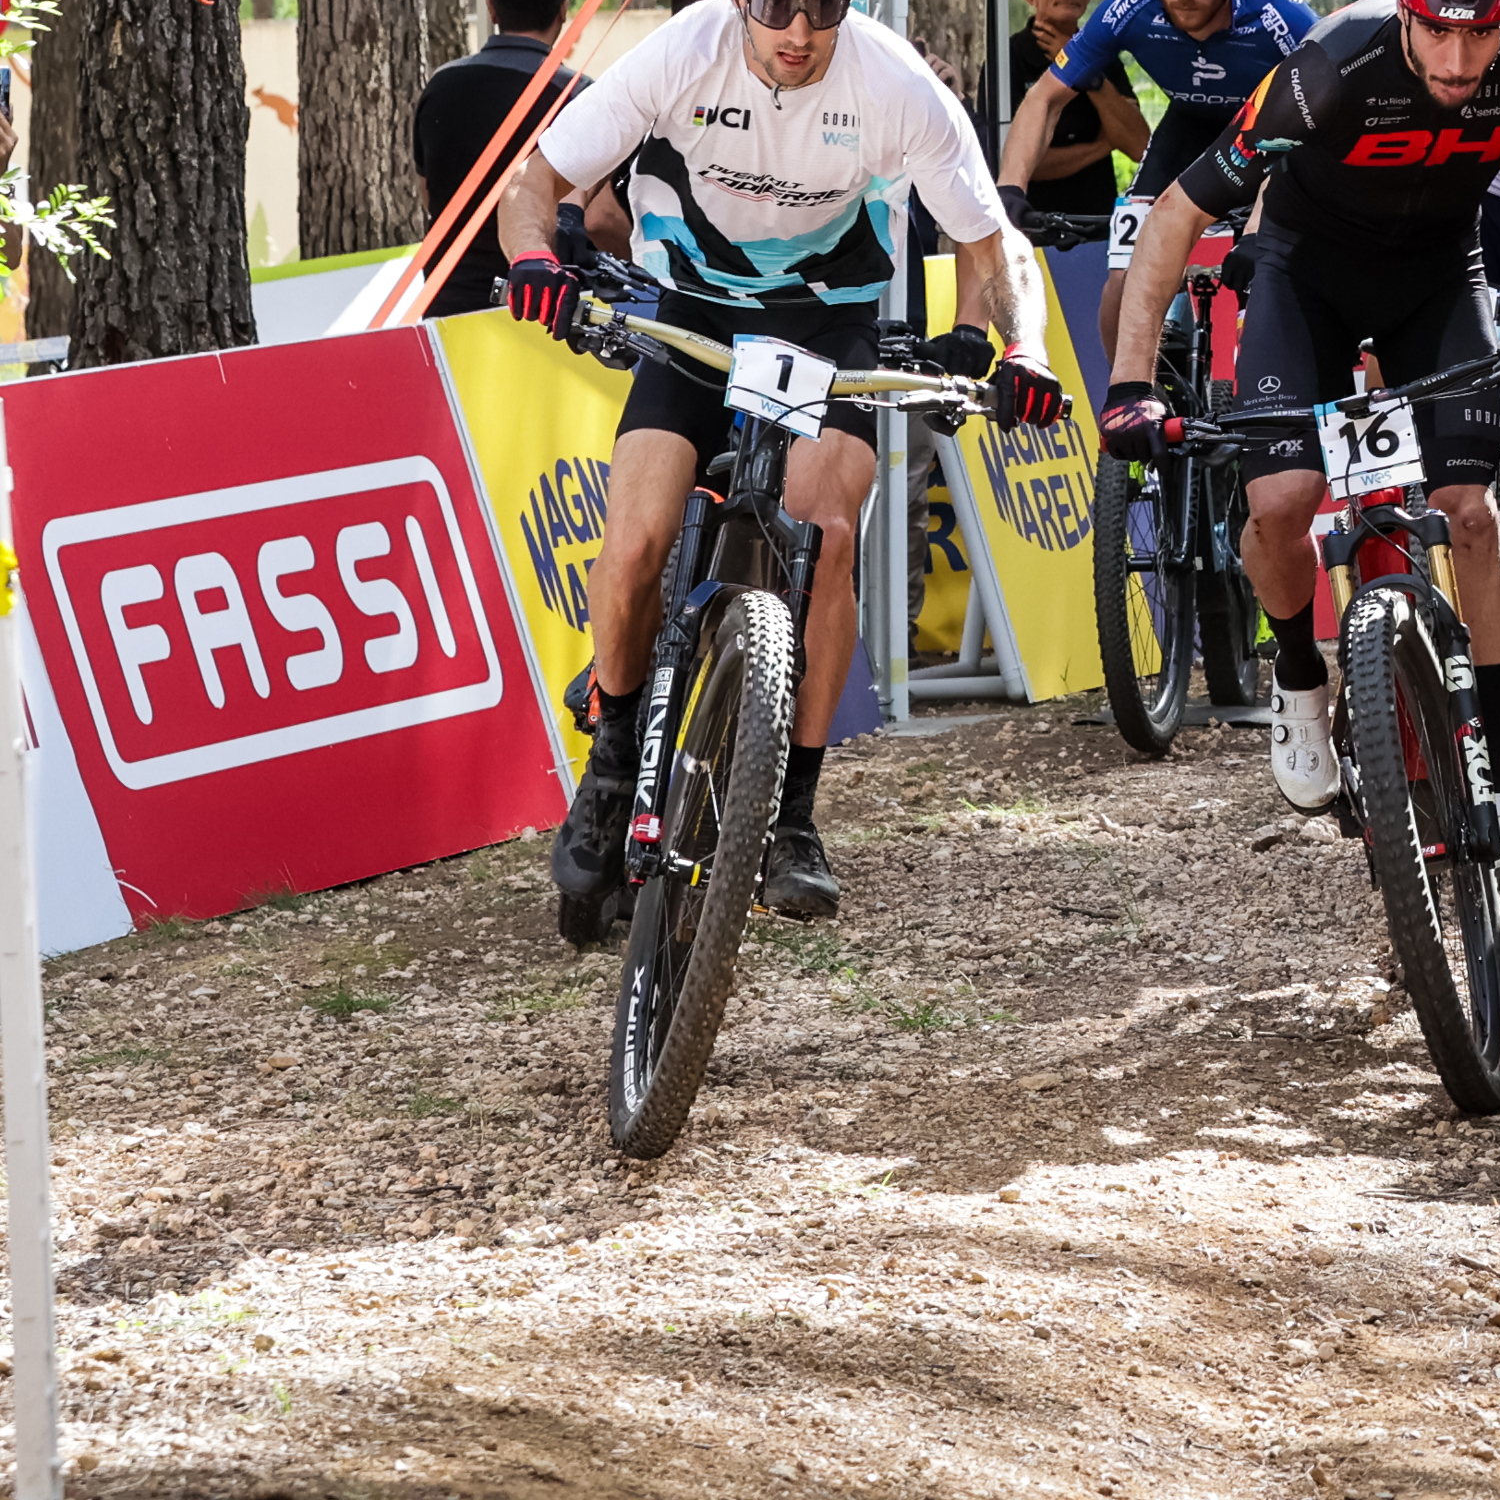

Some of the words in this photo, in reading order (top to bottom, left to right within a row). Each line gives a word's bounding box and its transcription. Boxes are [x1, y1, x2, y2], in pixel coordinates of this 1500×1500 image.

[1439, 7, 1475, 21] LAZER
[1340, 46, 1385, 77] SHIMANO
[823, 112, 861, 128] GOBI
[775, 353, 795, 394] 1
[1338, 421, 1400, 465] 16
[101, 515, 458, 726] FASSI
[1463, 734, 1496, 806] FOX
